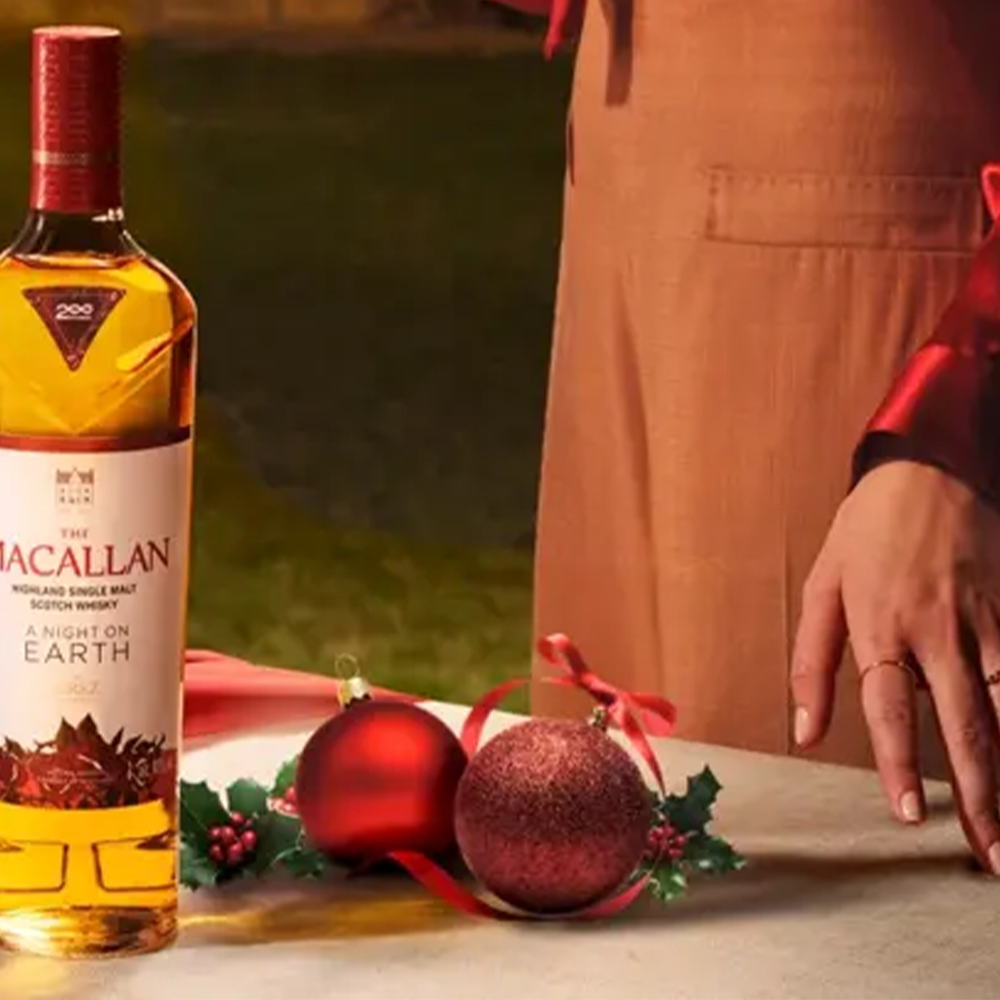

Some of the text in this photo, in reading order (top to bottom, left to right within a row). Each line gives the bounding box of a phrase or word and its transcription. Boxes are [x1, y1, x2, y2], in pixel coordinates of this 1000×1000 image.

[56, 303, 94, 320] 200
[61, 529, 89, 539] THE
[12, 583, 137, 597] HIGHLAND SINGLE MALT
[30, 599, 118, 610] SCOTCH WHISKY
[26, 625, 129, 639] A NIGHT ON
[24, 640, 130, 663] EARTH
